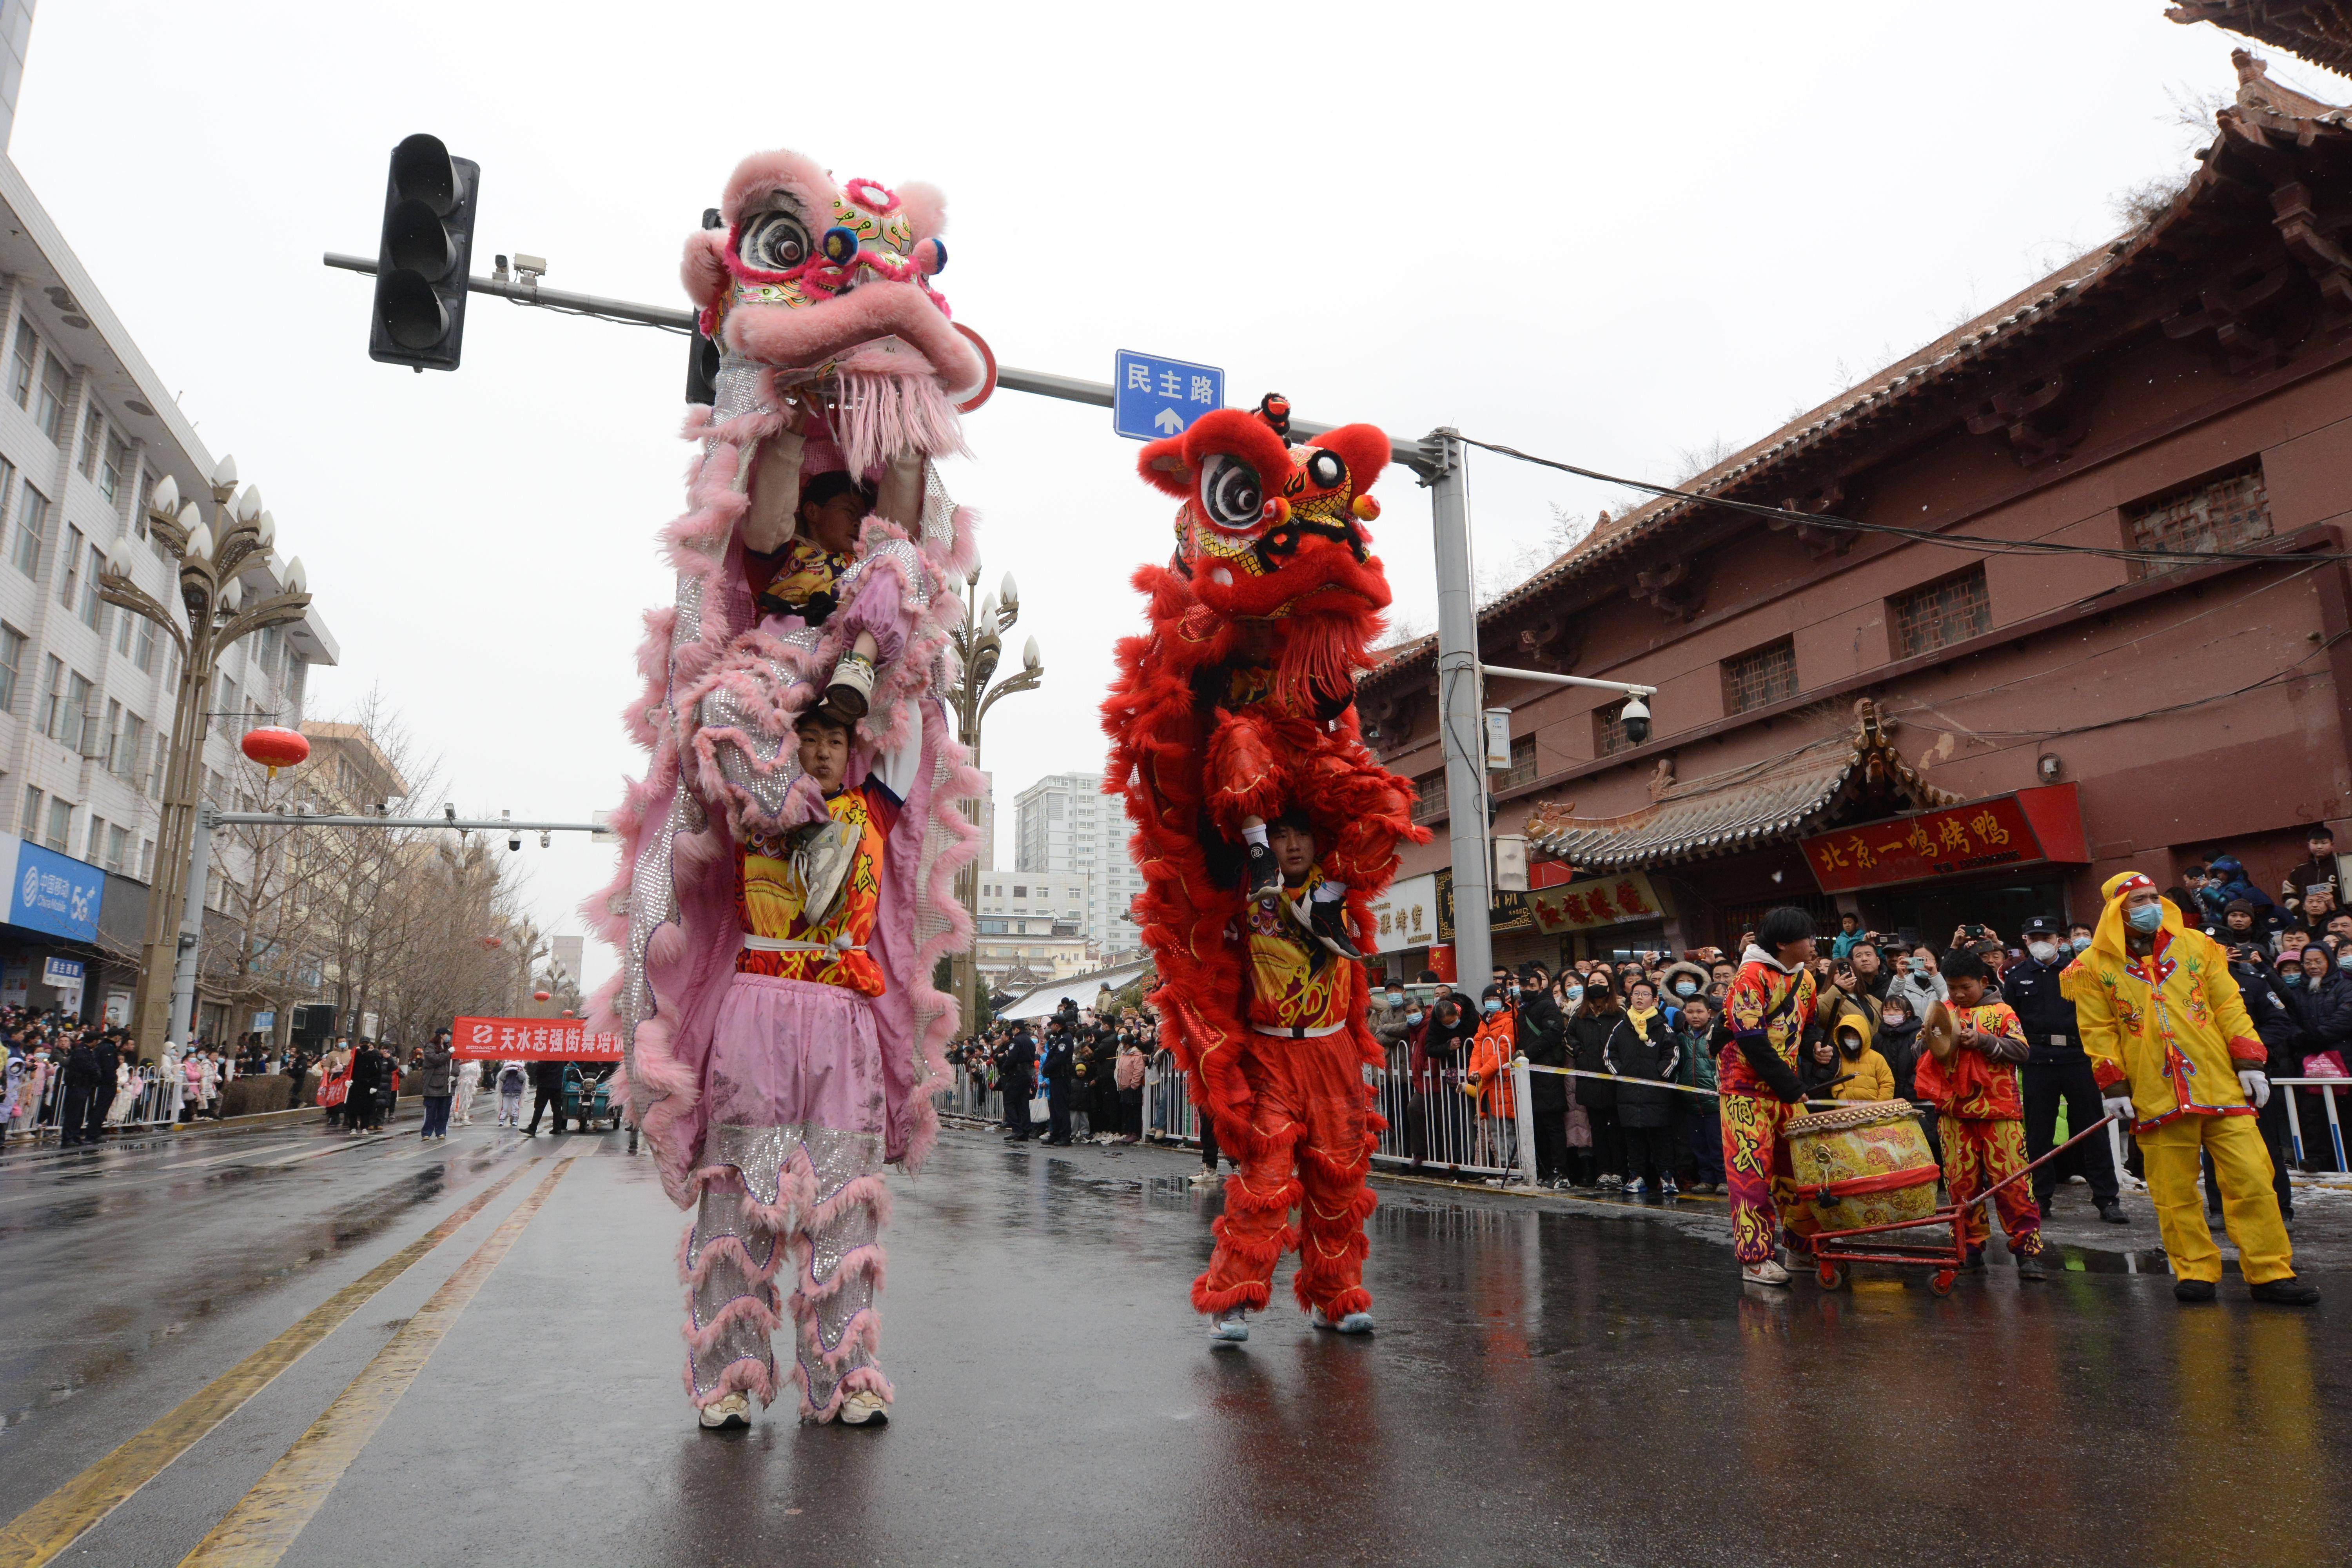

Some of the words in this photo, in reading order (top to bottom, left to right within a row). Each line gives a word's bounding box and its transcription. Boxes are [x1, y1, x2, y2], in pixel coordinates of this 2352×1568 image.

[1128, 363, 1213, 405] 民主路
[1820, 810, 2009, 871] 北京一鸣烤鸭
[40, 873, 69, 898] 中国移动
[38, 895, 51, 909] China
[51, 898, 66, 913] Mobile
[52, 961, 79, 976] 民主西路
